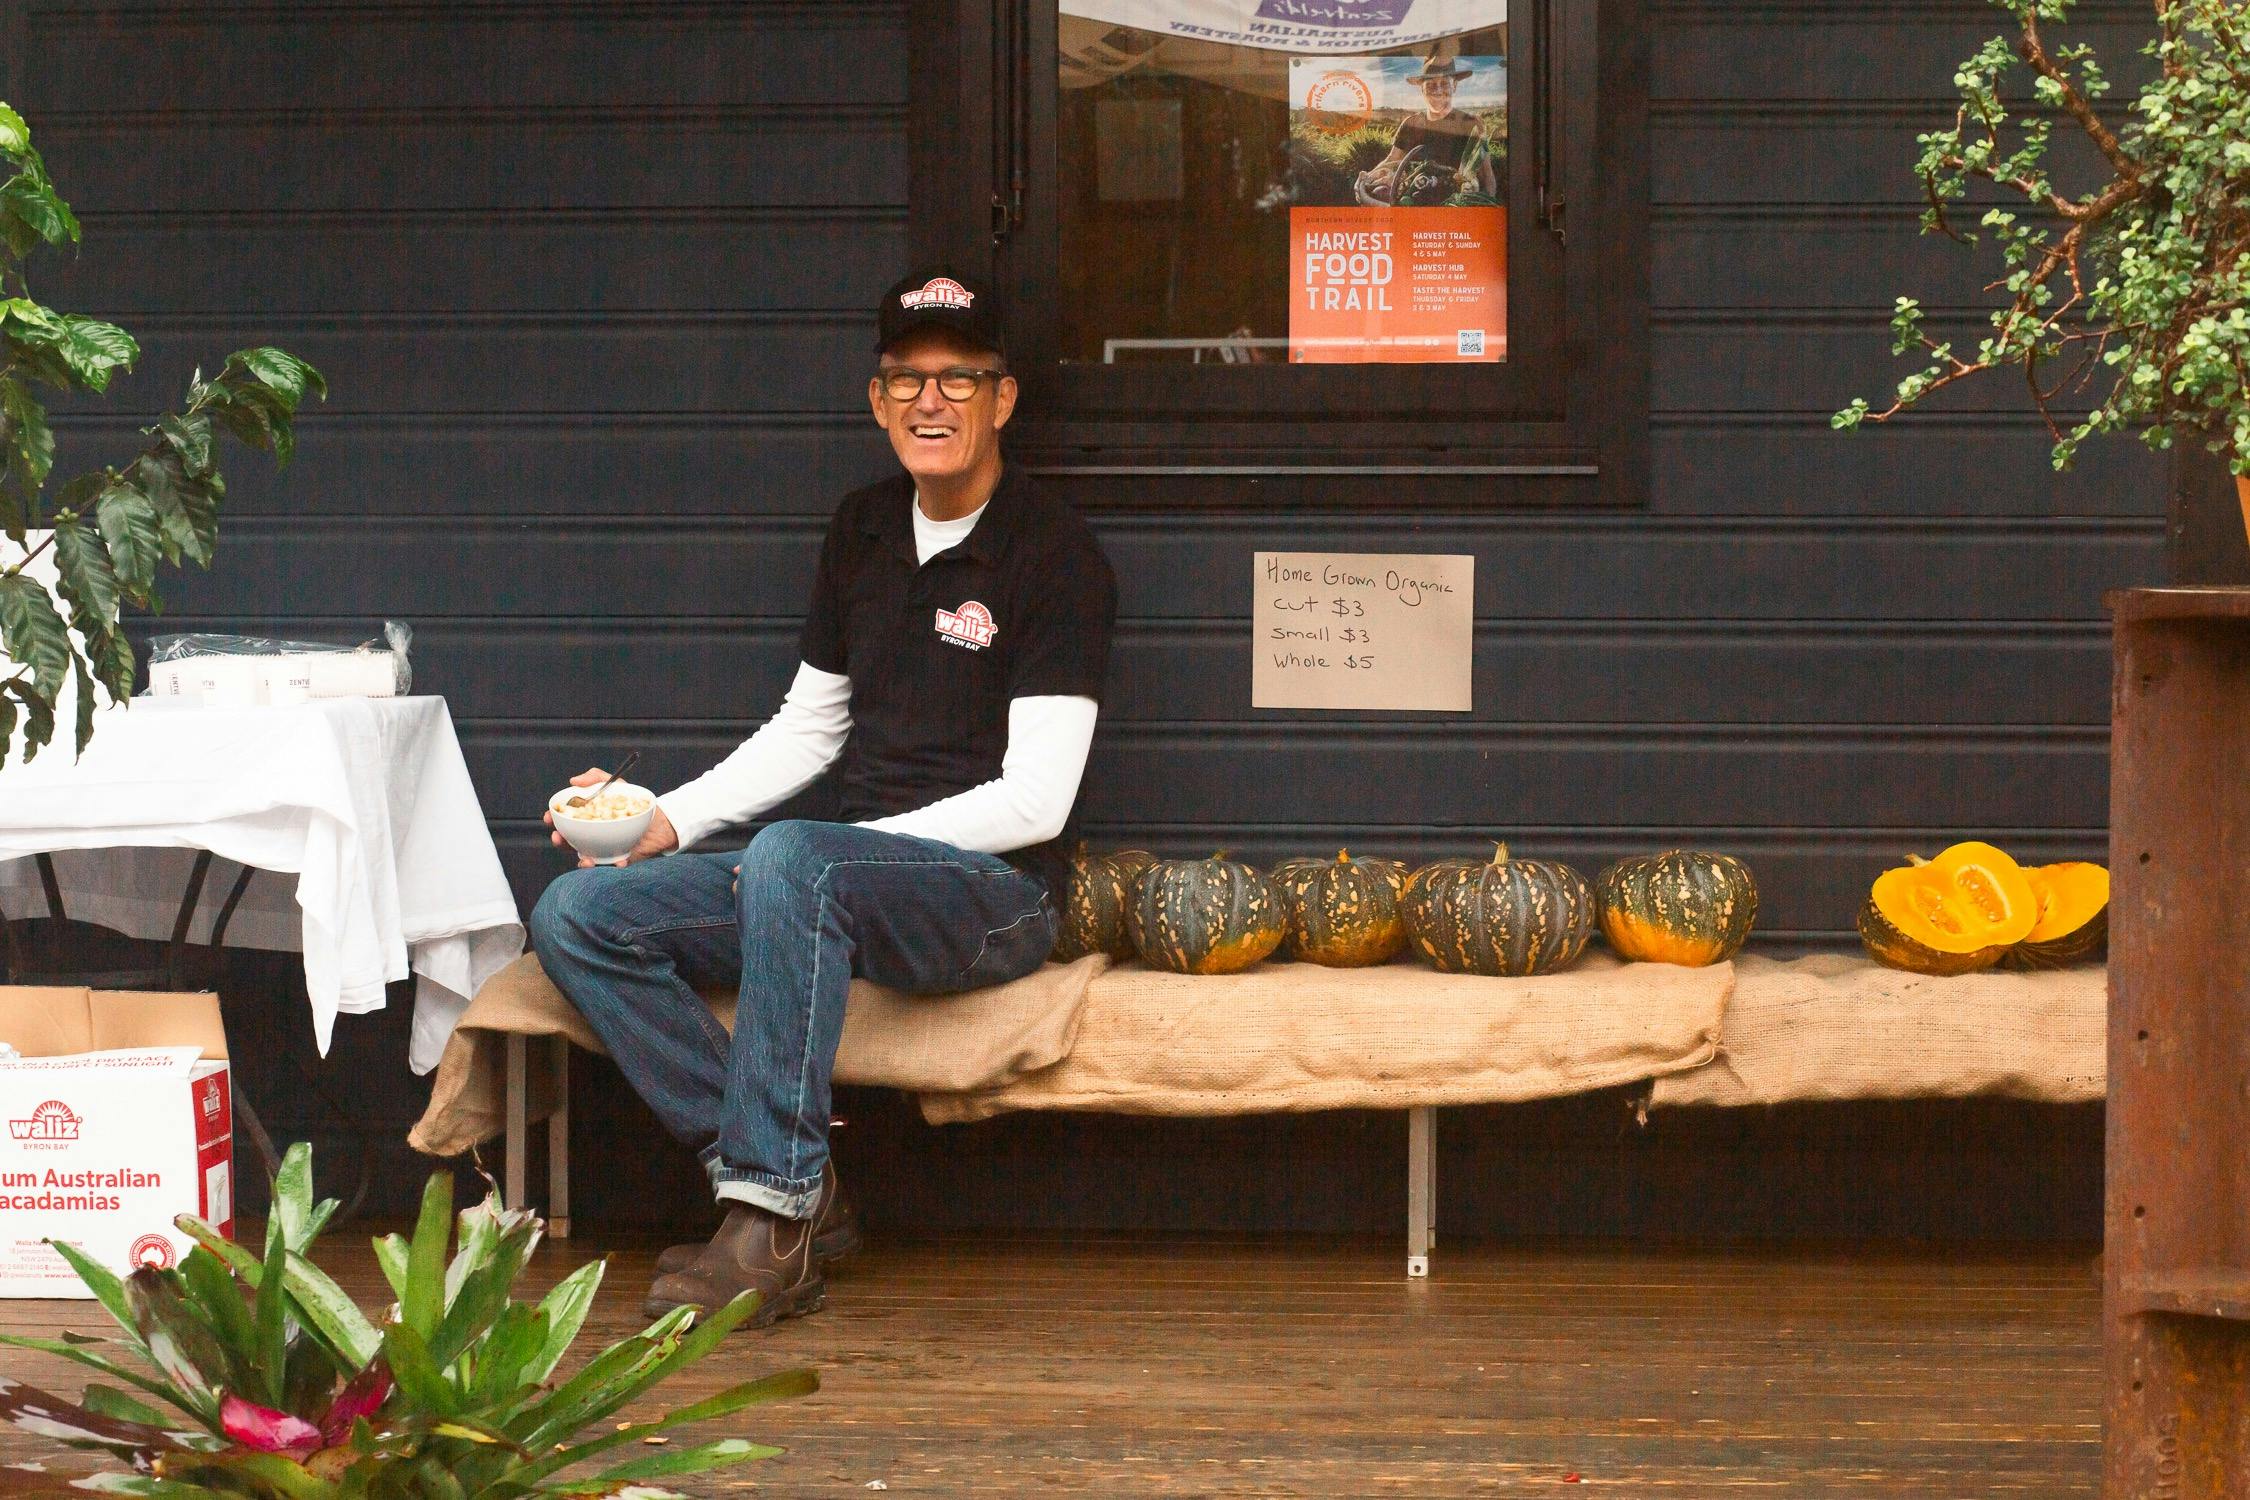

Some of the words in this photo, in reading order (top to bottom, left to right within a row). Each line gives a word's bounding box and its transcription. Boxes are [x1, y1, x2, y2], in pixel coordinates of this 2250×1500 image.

[1306, 232, 1393, 251] HARVEST
[1412, 232, 1446, 240] HARVEST
[1449, 232, 1471, 240] TRAIL
[1306, 253, 1393, 285] FOOD
[903, 288, 970, 305] waliz
[1305, 287, 1393, 310] TRAIL
[1413, 286, 1435, 294] TASTE
[1437, 286, 1450, 294] THE
[1453, 286, 1485, 294] HARVEST
[1267, 557, 1313, 583] Home
[1323, 564, 1376, 588] Grown
[1386, 570, 1454, 607] Organic
[1331, 596, 1365, 618] $3
[937, 612, 991, 644] waliz
[1339, 627, 1370, 643] $3
[941, 634, 966, 647] BYRON
[965, 642, 981, 651] BAY
[1344, 655, 1375, 669] $5
[10, 1115, 78, 1139] waliz
[43, 1168, 160, 1188] Australian
[0, 1191, 120, 1210] acadamias
